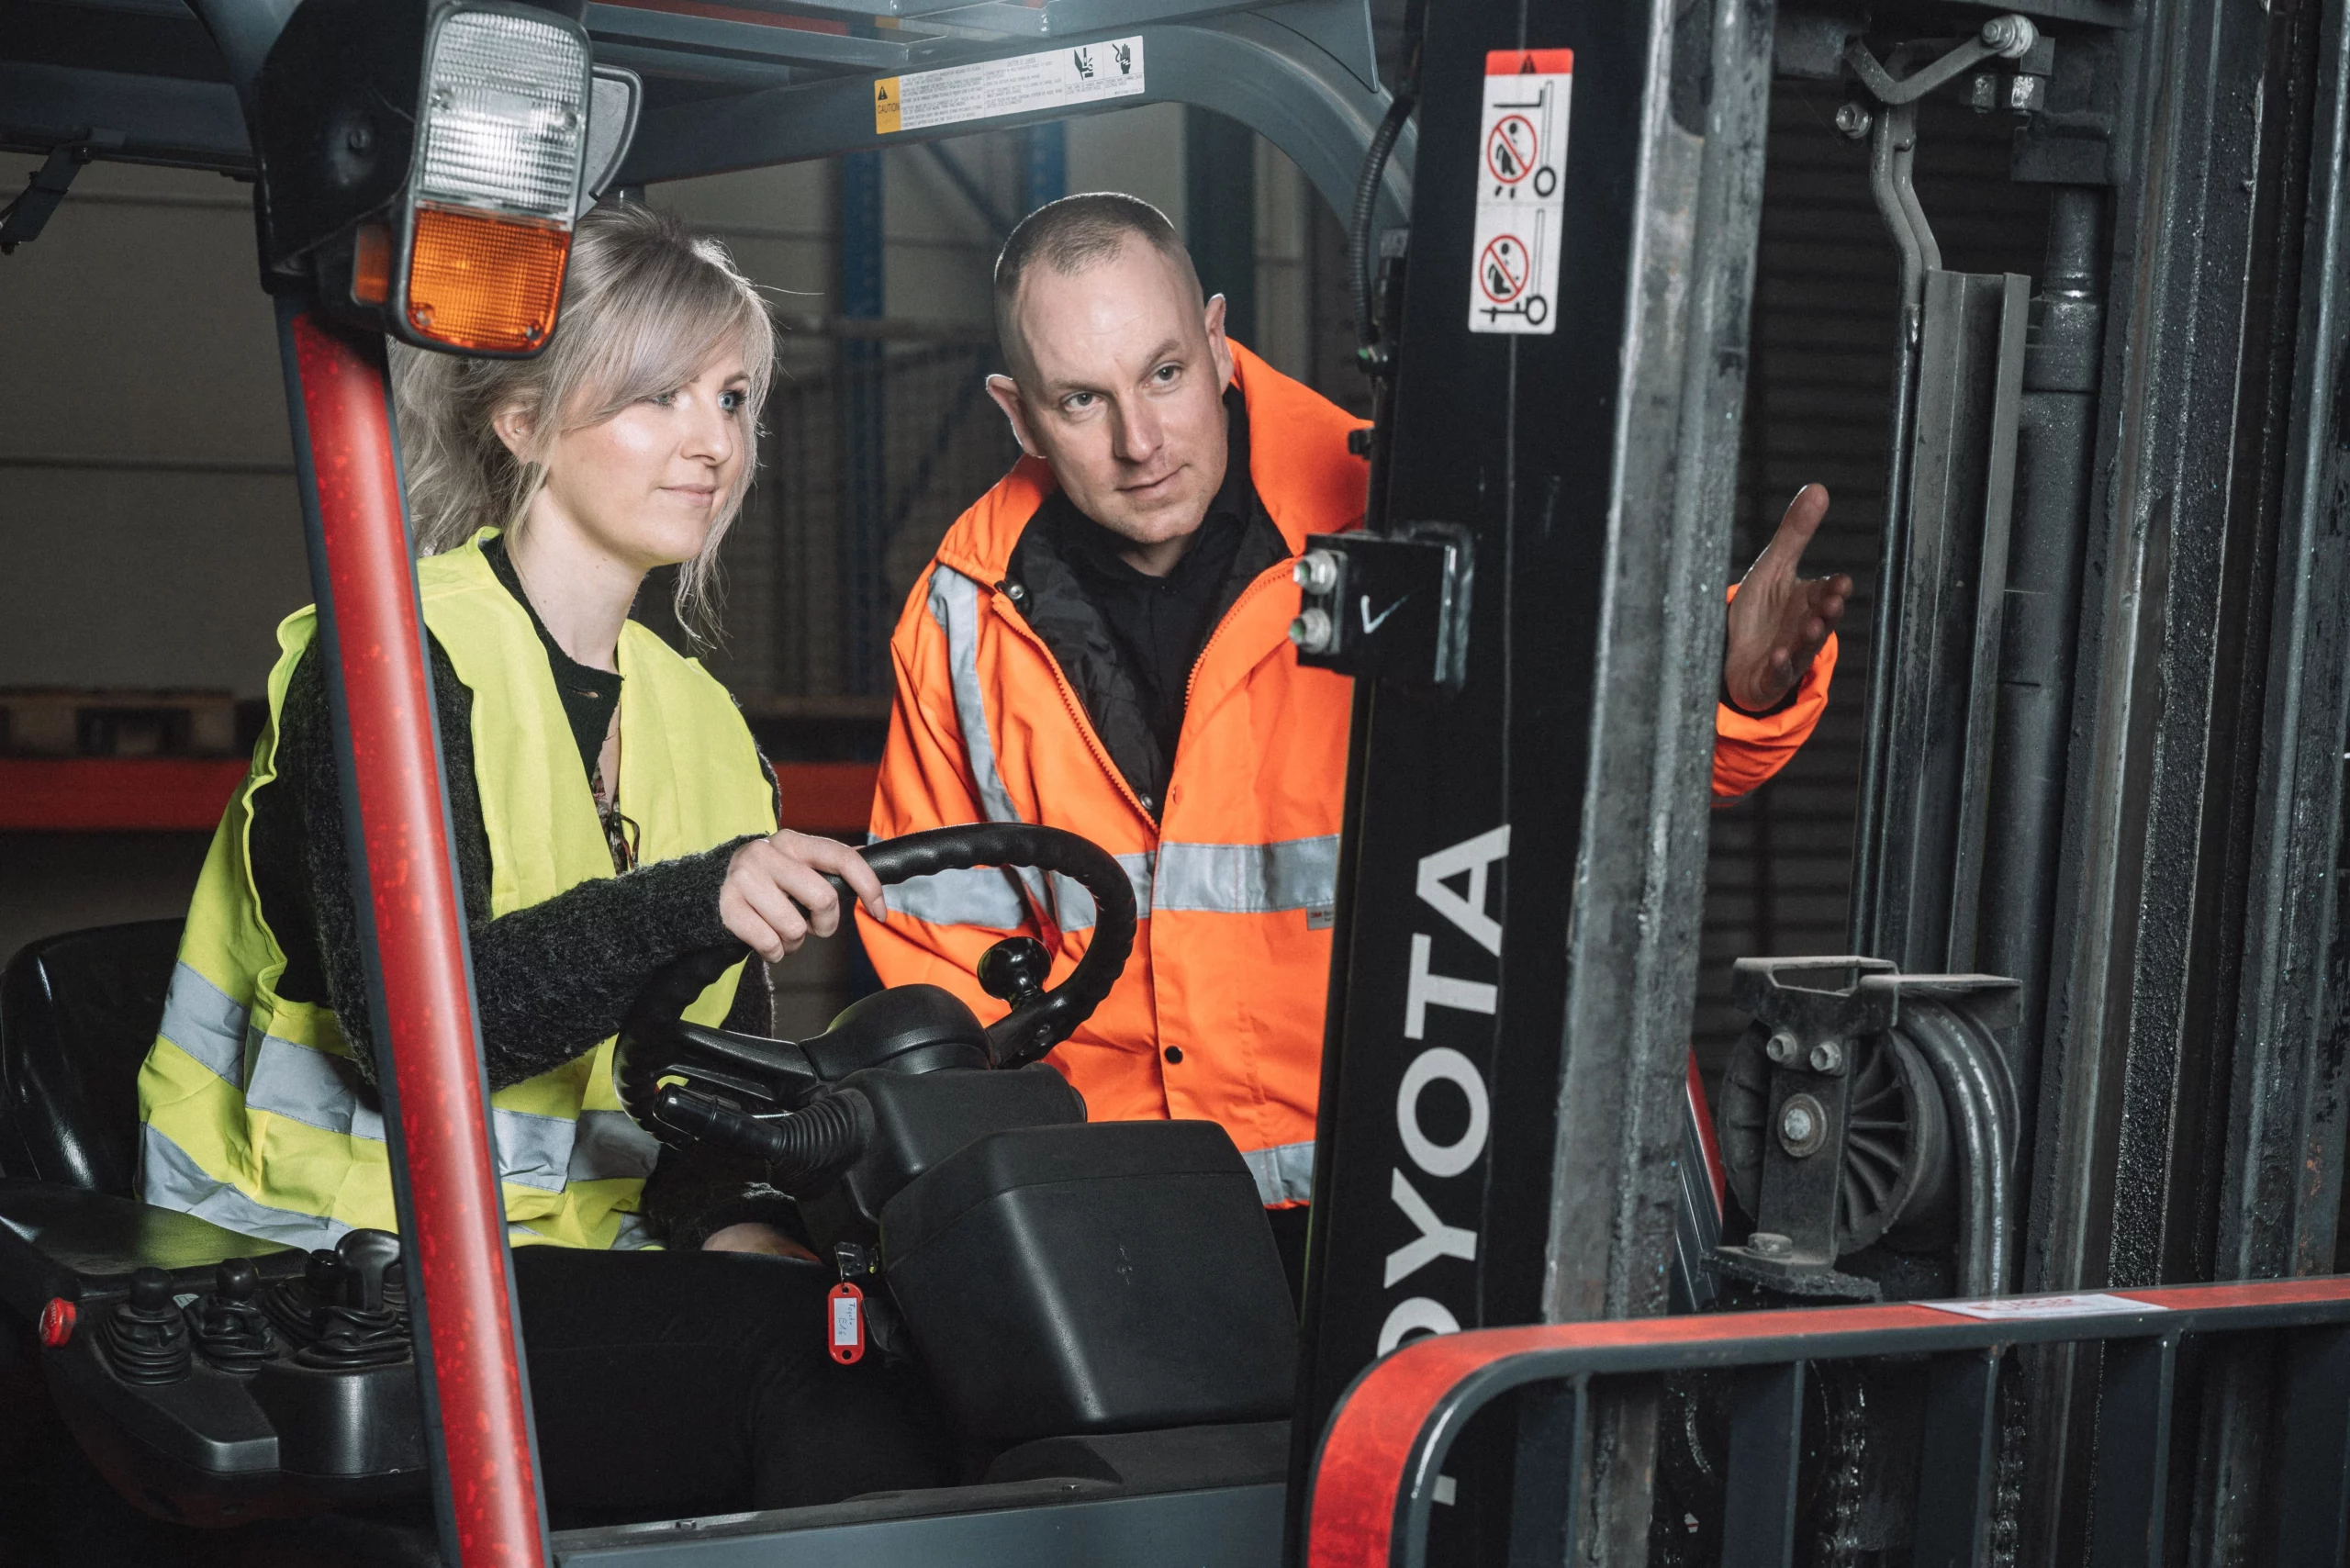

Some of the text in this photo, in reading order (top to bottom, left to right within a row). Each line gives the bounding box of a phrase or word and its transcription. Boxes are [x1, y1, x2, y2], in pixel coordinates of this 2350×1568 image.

[877, 103, 900, 115] CAUTION
[1377, 823, 1511, 1506] YOTA
[846, 1302, 856, 1326] Toyota
